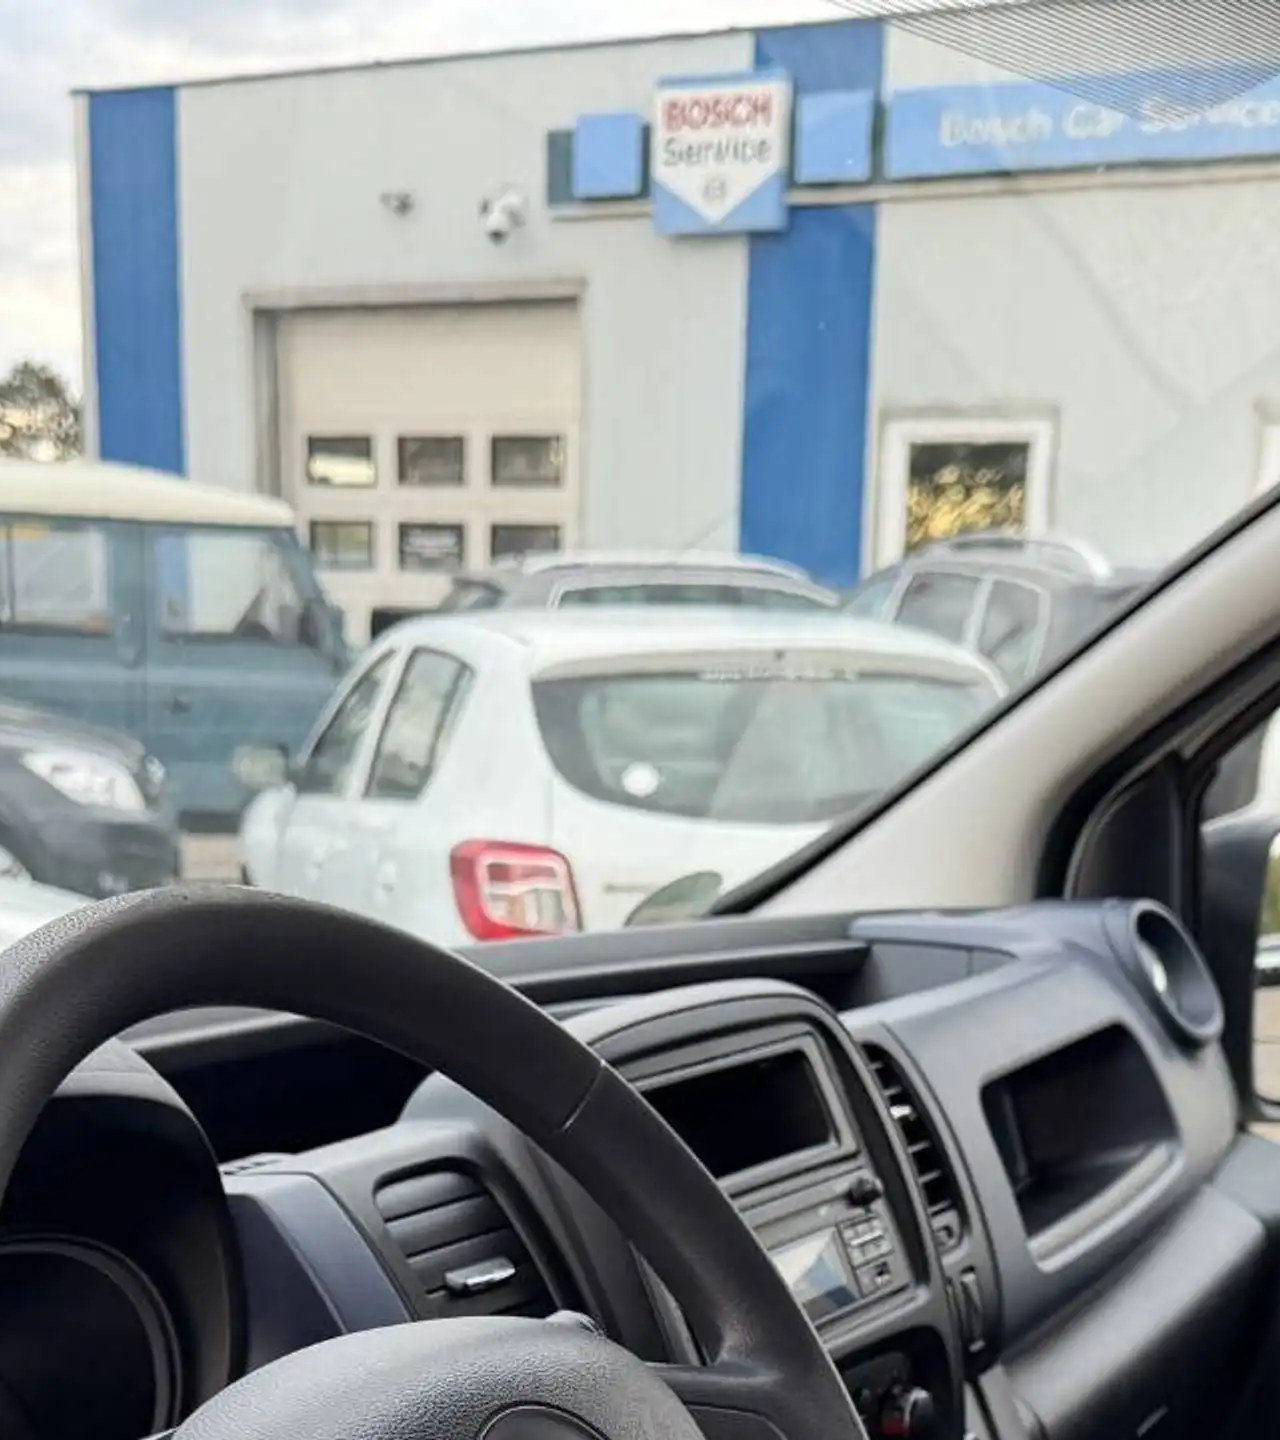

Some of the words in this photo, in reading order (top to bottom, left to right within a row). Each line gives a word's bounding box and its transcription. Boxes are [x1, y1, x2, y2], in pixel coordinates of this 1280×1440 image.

[664, 92, 773, 131] BOSCH
[939, 106, 1052, 147] Bosch
[662, 136, 773, 167] Service
